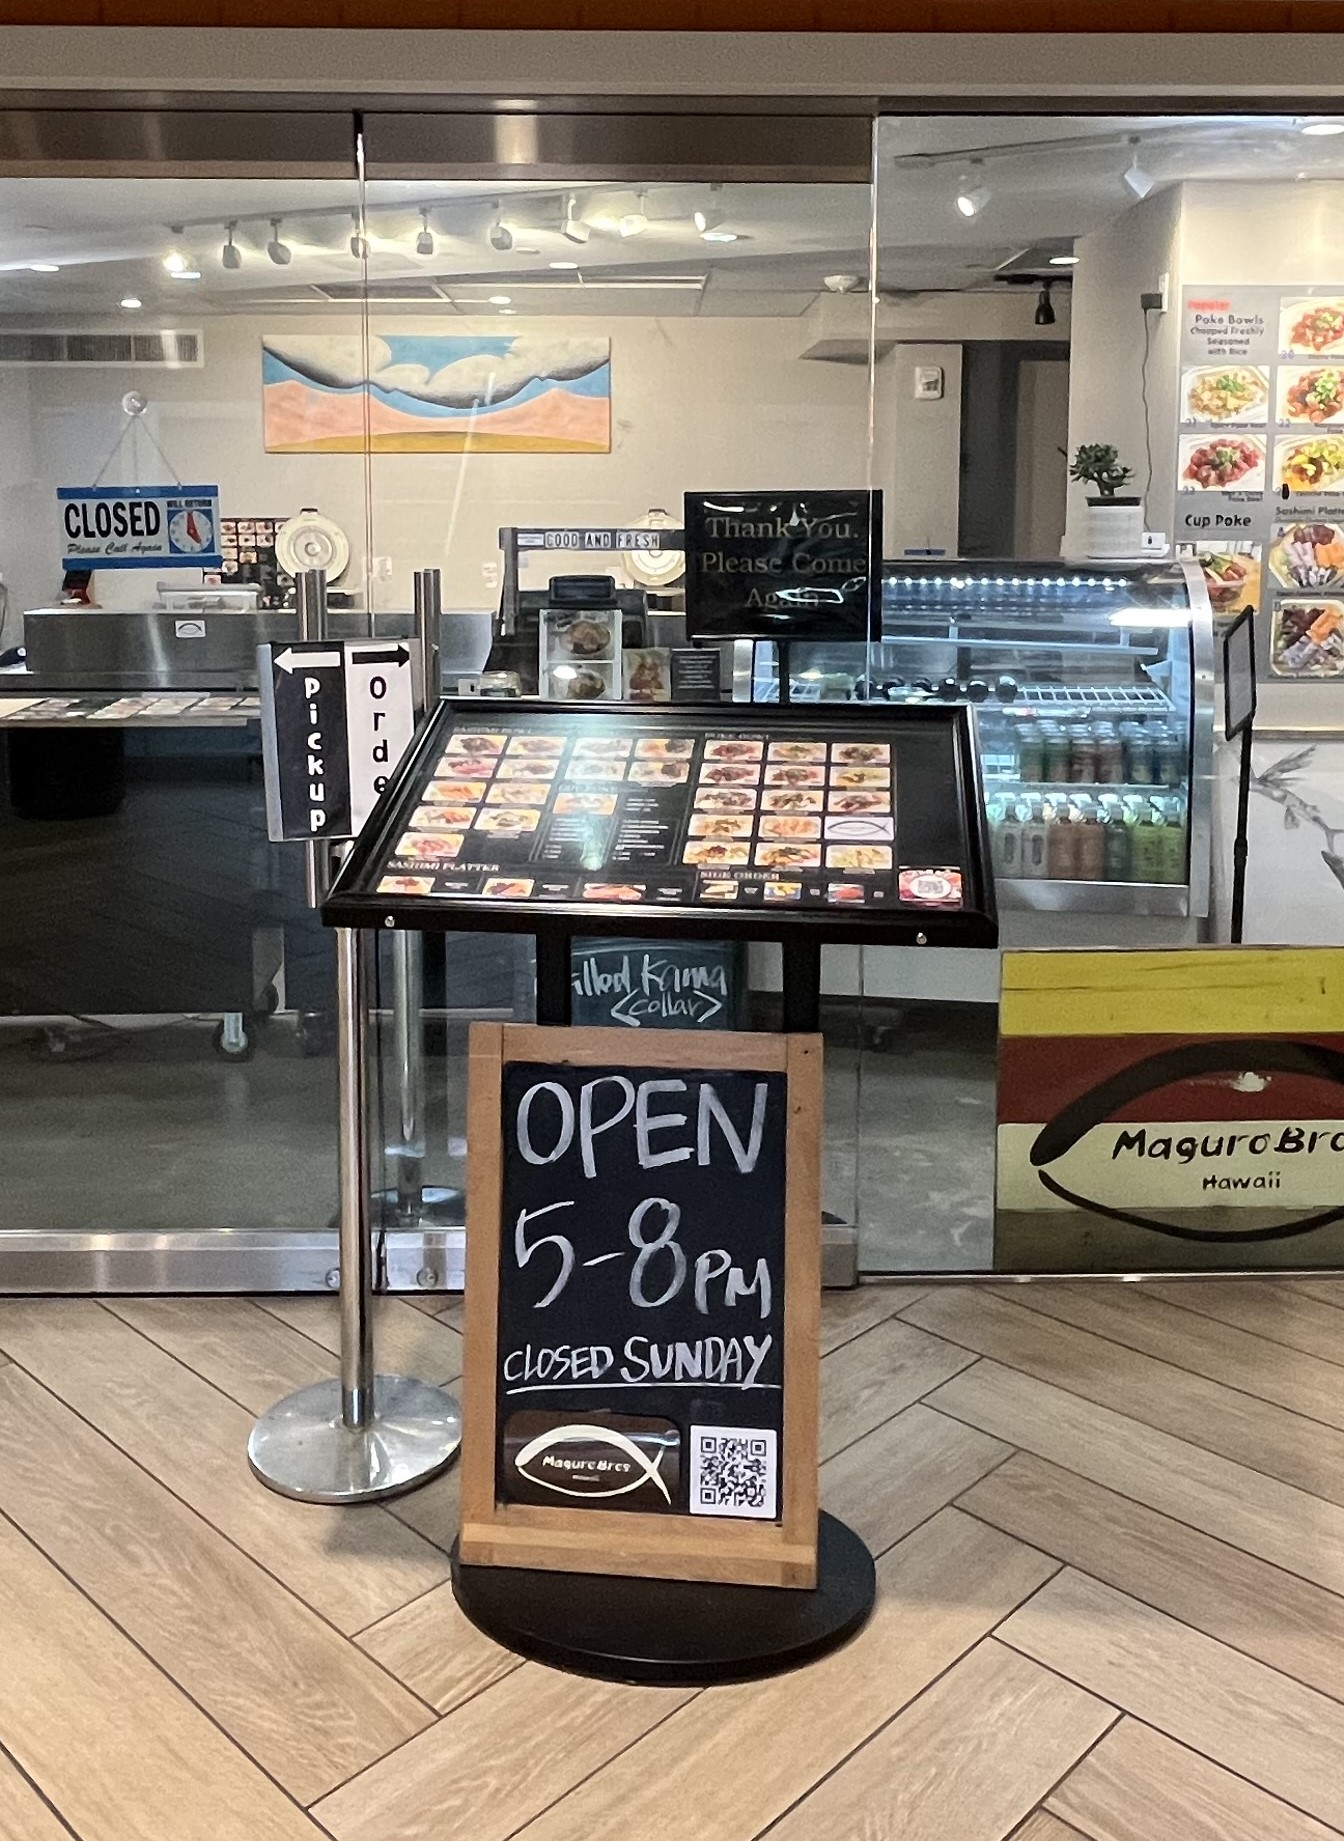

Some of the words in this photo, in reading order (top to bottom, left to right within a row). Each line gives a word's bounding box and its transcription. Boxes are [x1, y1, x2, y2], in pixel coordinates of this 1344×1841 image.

[1195, 314, 1224, 325] Poke
[1228, 314, 1264, 325] Bowls
[64, 501, 161, 539] CLOSED
[706, 516, 791, 539] Thank
[800, 516, 859, 539] You.
[1184, 514, 1211, 529] Cup
[1215, 514, 1252, 527] Poke
[67, 543, 101, 555] Please
[105, 541, 129, 555] Call
[545, 532, 579, 548] GOOD
[585, 532, 611, 548] AND
[617, 532, 660, 548] FRESH
[702, 552, 784, 574] Please
[792, 552, 867, 574] Come
[369, 676, 391, 795] Orde
[304, 677, 327, 833] Pickup
[442, 861, 500, 872] PLATTER
[516, 1075, 769, 1178] OPEN
[1202, 1171, 1282, 1191] Hawaii
[503, 1343, 615, 1382] CLOSED
[619, 1334, 773, 1391] SUNDAY
